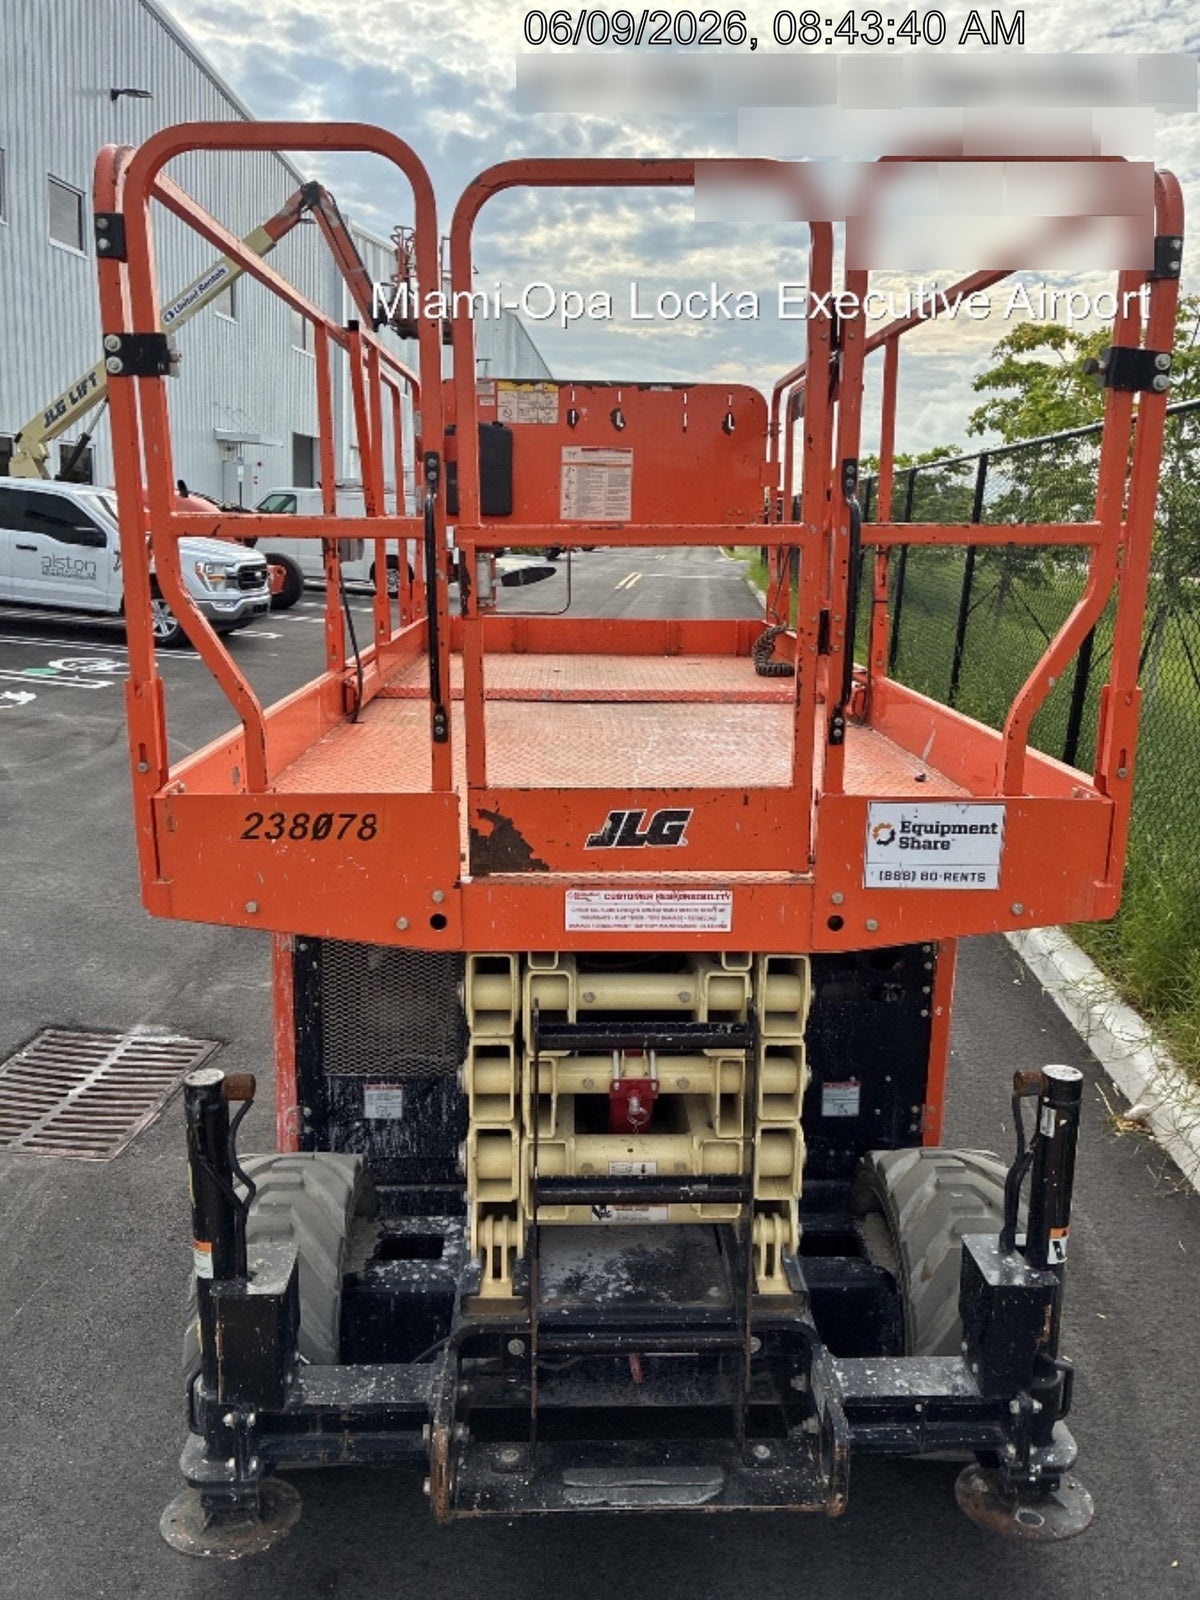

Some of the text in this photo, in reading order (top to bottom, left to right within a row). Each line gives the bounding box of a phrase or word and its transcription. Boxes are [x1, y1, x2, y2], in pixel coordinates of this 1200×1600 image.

[68, 371, 98, 405] LIFT
[583, 808, 694, 850] JLG
[899, 820, 998, 837] Equipment
[899, 836, 951, 851] Share
[879, 870, 917, 882] (888)
